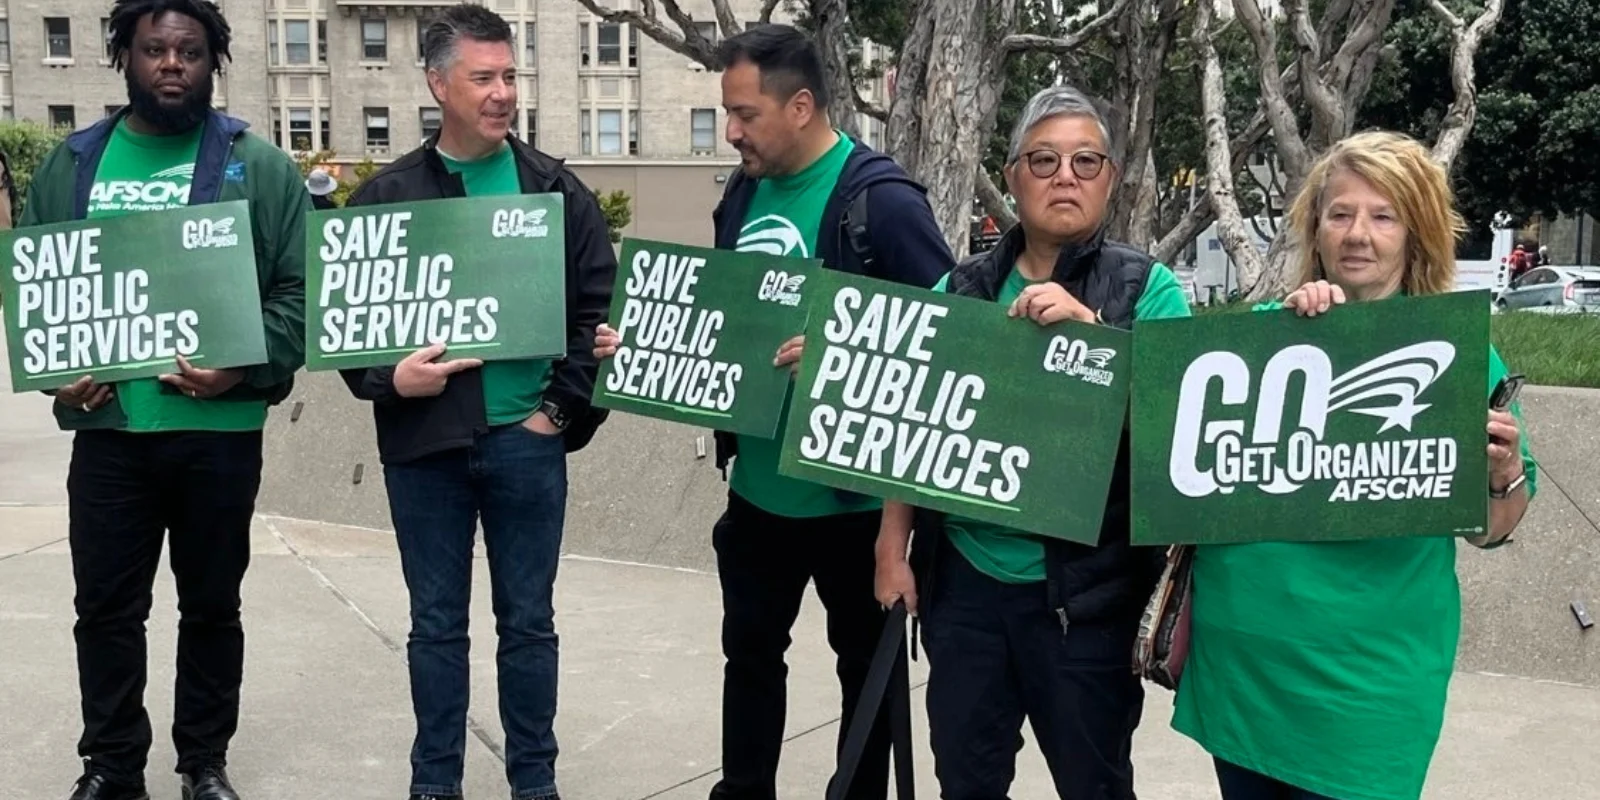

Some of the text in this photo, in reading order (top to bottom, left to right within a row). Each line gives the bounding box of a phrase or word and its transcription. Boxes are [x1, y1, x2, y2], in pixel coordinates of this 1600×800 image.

[182, 217, 212, 249] GO
[318, 212, 412, 263] SAVE
[491, 208, 524, 238] GO
[12, 228, 102, 283] SAVE
[318, 251, 454, 307] PUBLIC
[625, 250, 707, 305] SAVE
[18, 269, 149, 329] PUBLIC
[757, 269, 788, 301] GO
[24, 309, 200, 374] SERVICES
[318, 296, 499, 353] SERVICES
[618, 298, 725, 358] PUBLIC
[824, 287, 949, 362] SAVE
[606, 346, 743, 412] SERVICES
[1043, 335, 1088, 377] GO
[810, 345, 985, 431] PUBLIC
[1169, 343, 1333, 498] GO
[799, 404, 1030, 503] SERVICES
[1215, 430, 1456, 483] GET ORGANIZED
[1328, 474, 1453, 502] AFSCME
